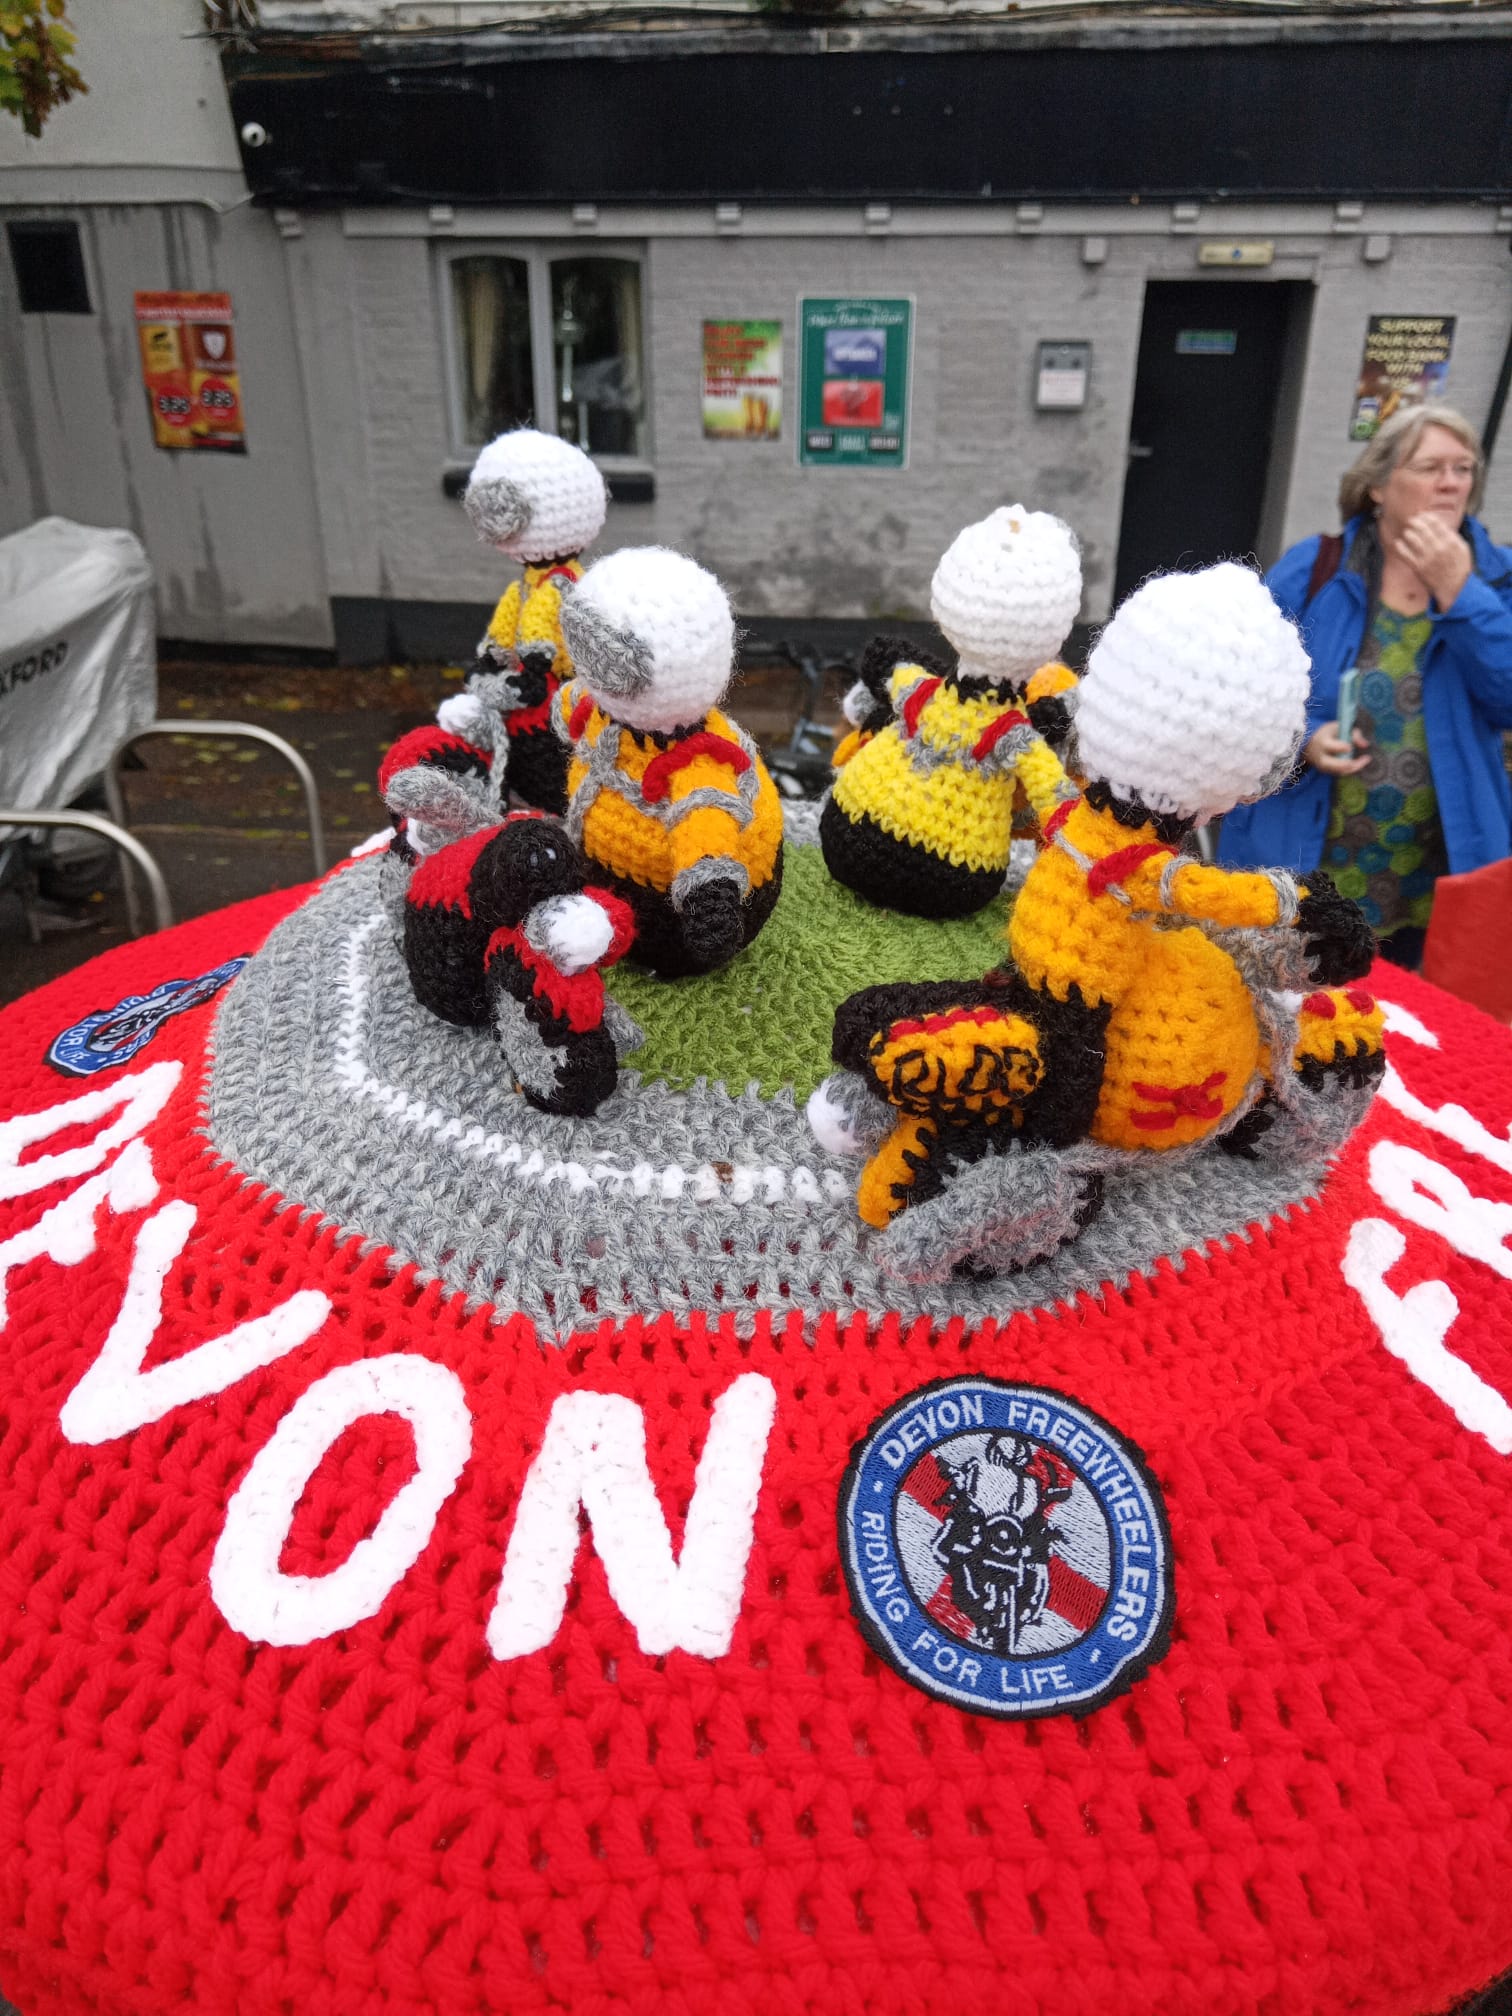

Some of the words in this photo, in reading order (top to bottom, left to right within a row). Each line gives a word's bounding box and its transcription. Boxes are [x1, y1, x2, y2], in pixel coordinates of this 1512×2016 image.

[861, 1509, 911, 1624] RIDING
[911, 1629, 982, 1687] FOR
[1000, 1664, 1075, 1695] LIFE
[878, 1393, 985, 1472] DEVON
[1006, 1400, 1151, 1643] FREEWHEELERS
